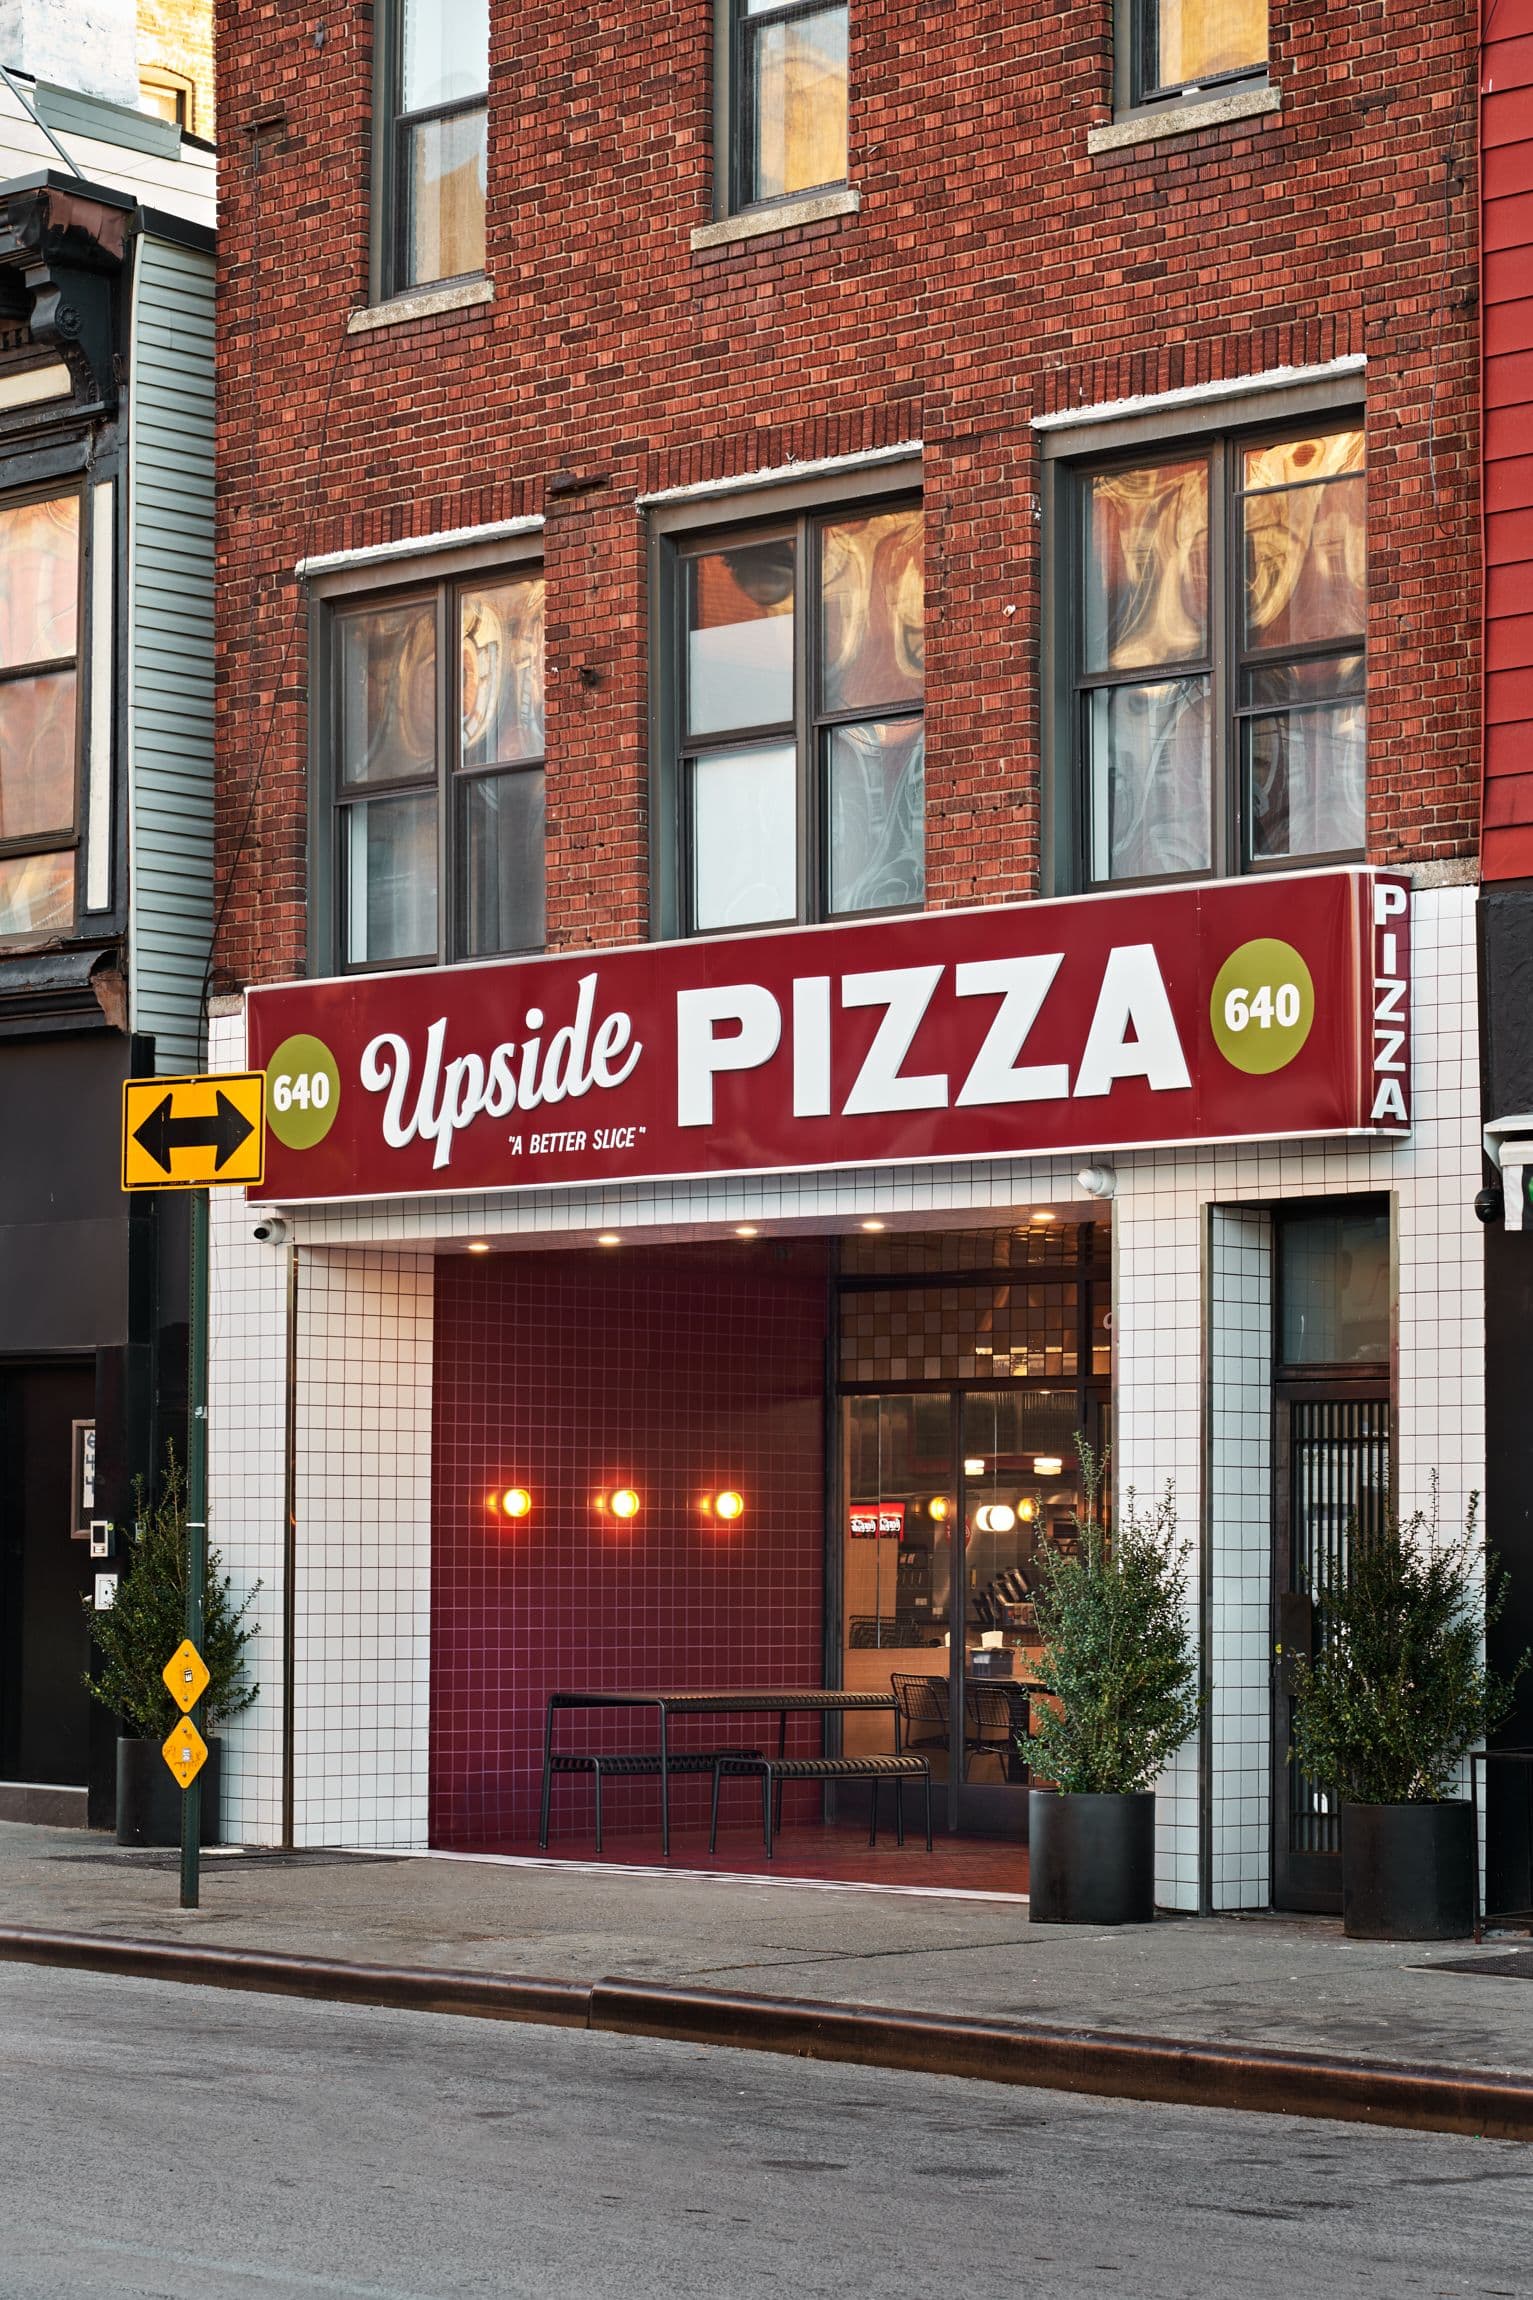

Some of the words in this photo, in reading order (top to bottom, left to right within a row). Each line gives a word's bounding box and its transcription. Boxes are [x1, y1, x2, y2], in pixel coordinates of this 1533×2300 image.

[1224, 982, 1301, 1032] 640
[1370, 884, 1408, 1121] PIZZA
[360, 972, 643, 1170] Upside
[677, 943, 1193, 1128] PIZZA
[272, 1071, 330, 1113] 640
[508, 1135, 523, 1156] "A
[529, 1130, 587, 1154] BETTER
